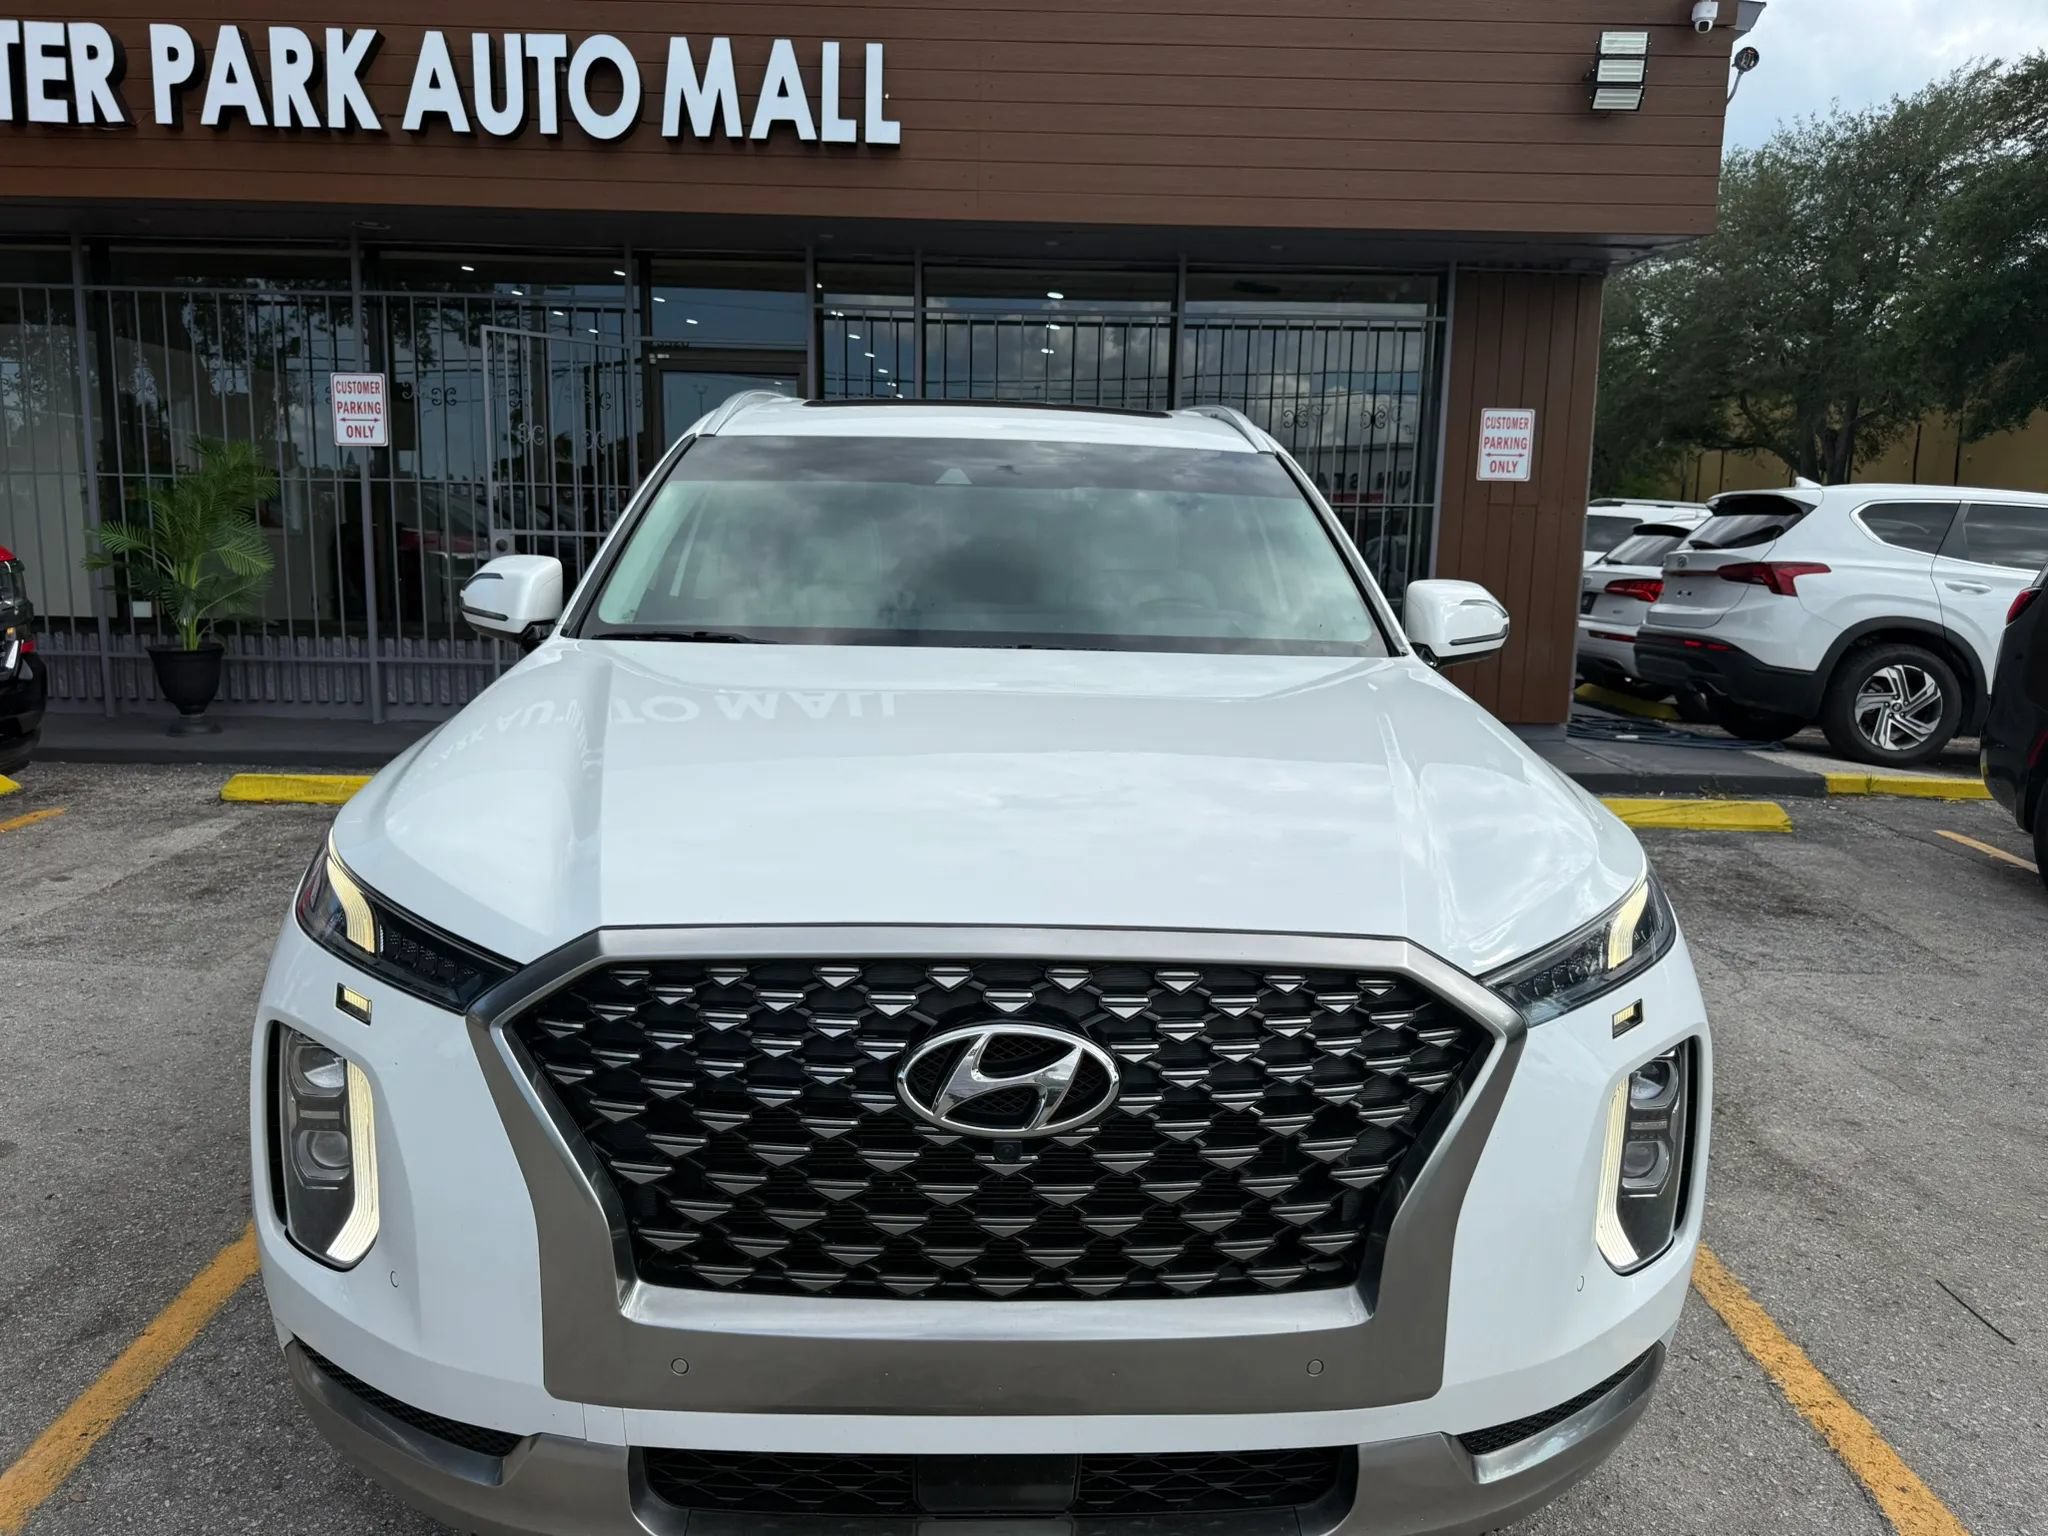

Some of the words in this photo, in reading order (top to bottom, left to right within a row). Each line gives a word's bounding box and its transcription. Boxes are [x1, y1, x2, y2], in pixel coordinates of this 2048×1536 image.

[149, 23, 383, 130] PARK
[402, 30, 641, 139] AUTO
[661, 37, 902, 144] MALL
[336, 381, 381, 394] CUSTOMER
[337, 401, 381, 415] PARKING
[1485, 417, 1529, 430] CUSTOMER
[346, 425, 375, 438] ONLY
[1484, 437, 1528, 450] PARKING
[1490, 460, 1519, 473] ONLY
